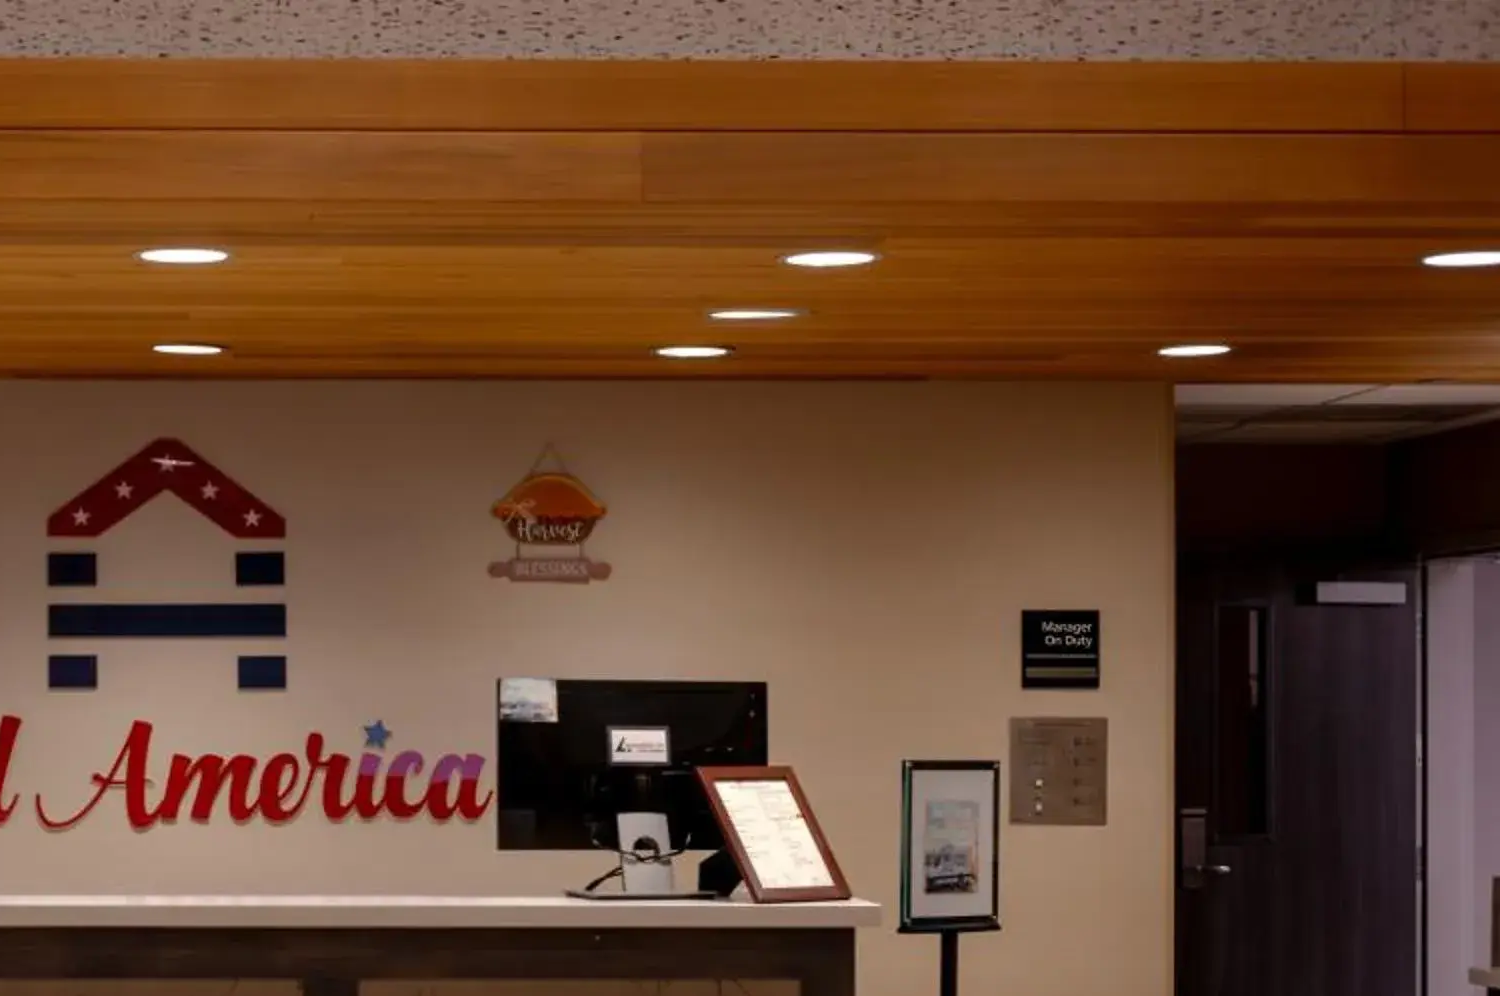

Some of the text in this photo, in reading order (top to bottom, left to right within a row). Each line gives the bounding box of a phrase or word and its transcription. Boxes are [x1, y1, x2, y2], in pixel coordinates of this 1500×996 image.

[517, 518, 584, 542] Harvest
[1041, 621, 1092, 634] Manager
[1044, 635, 1093, 649] On Duty
[35, 719, 494, 832] America
